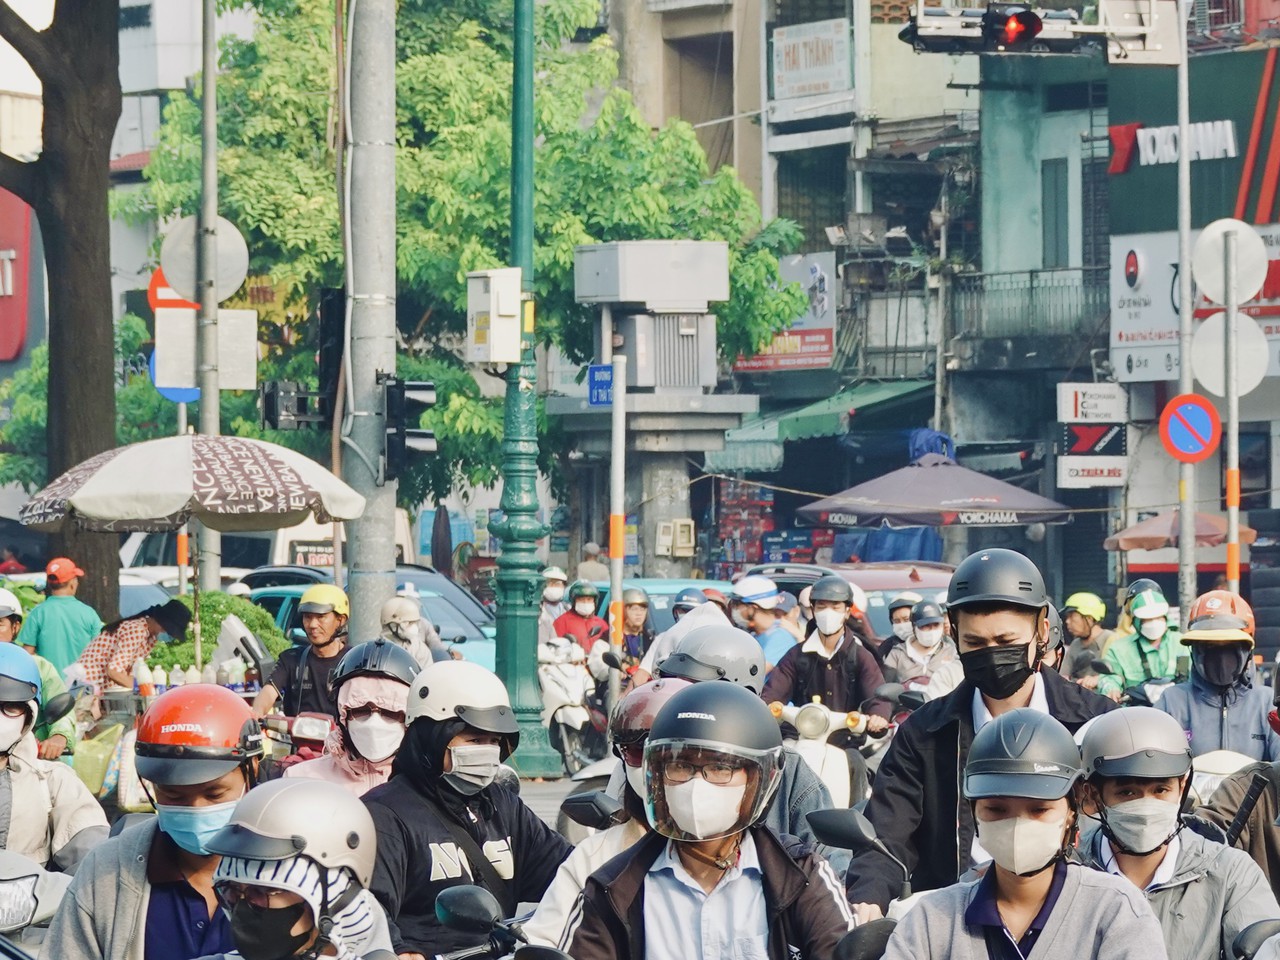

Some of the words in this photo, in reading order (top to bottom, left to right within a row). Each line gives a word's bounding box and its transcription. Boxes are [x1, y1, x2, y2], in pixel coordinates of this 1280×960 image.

[1136, 119, 1236, 166] YOKOAMA
[958, 511, 1018, 524] YOKOHAMA
[677, 712, 716, 721] HONDA
[161, 723, 203, 734] HONDA
